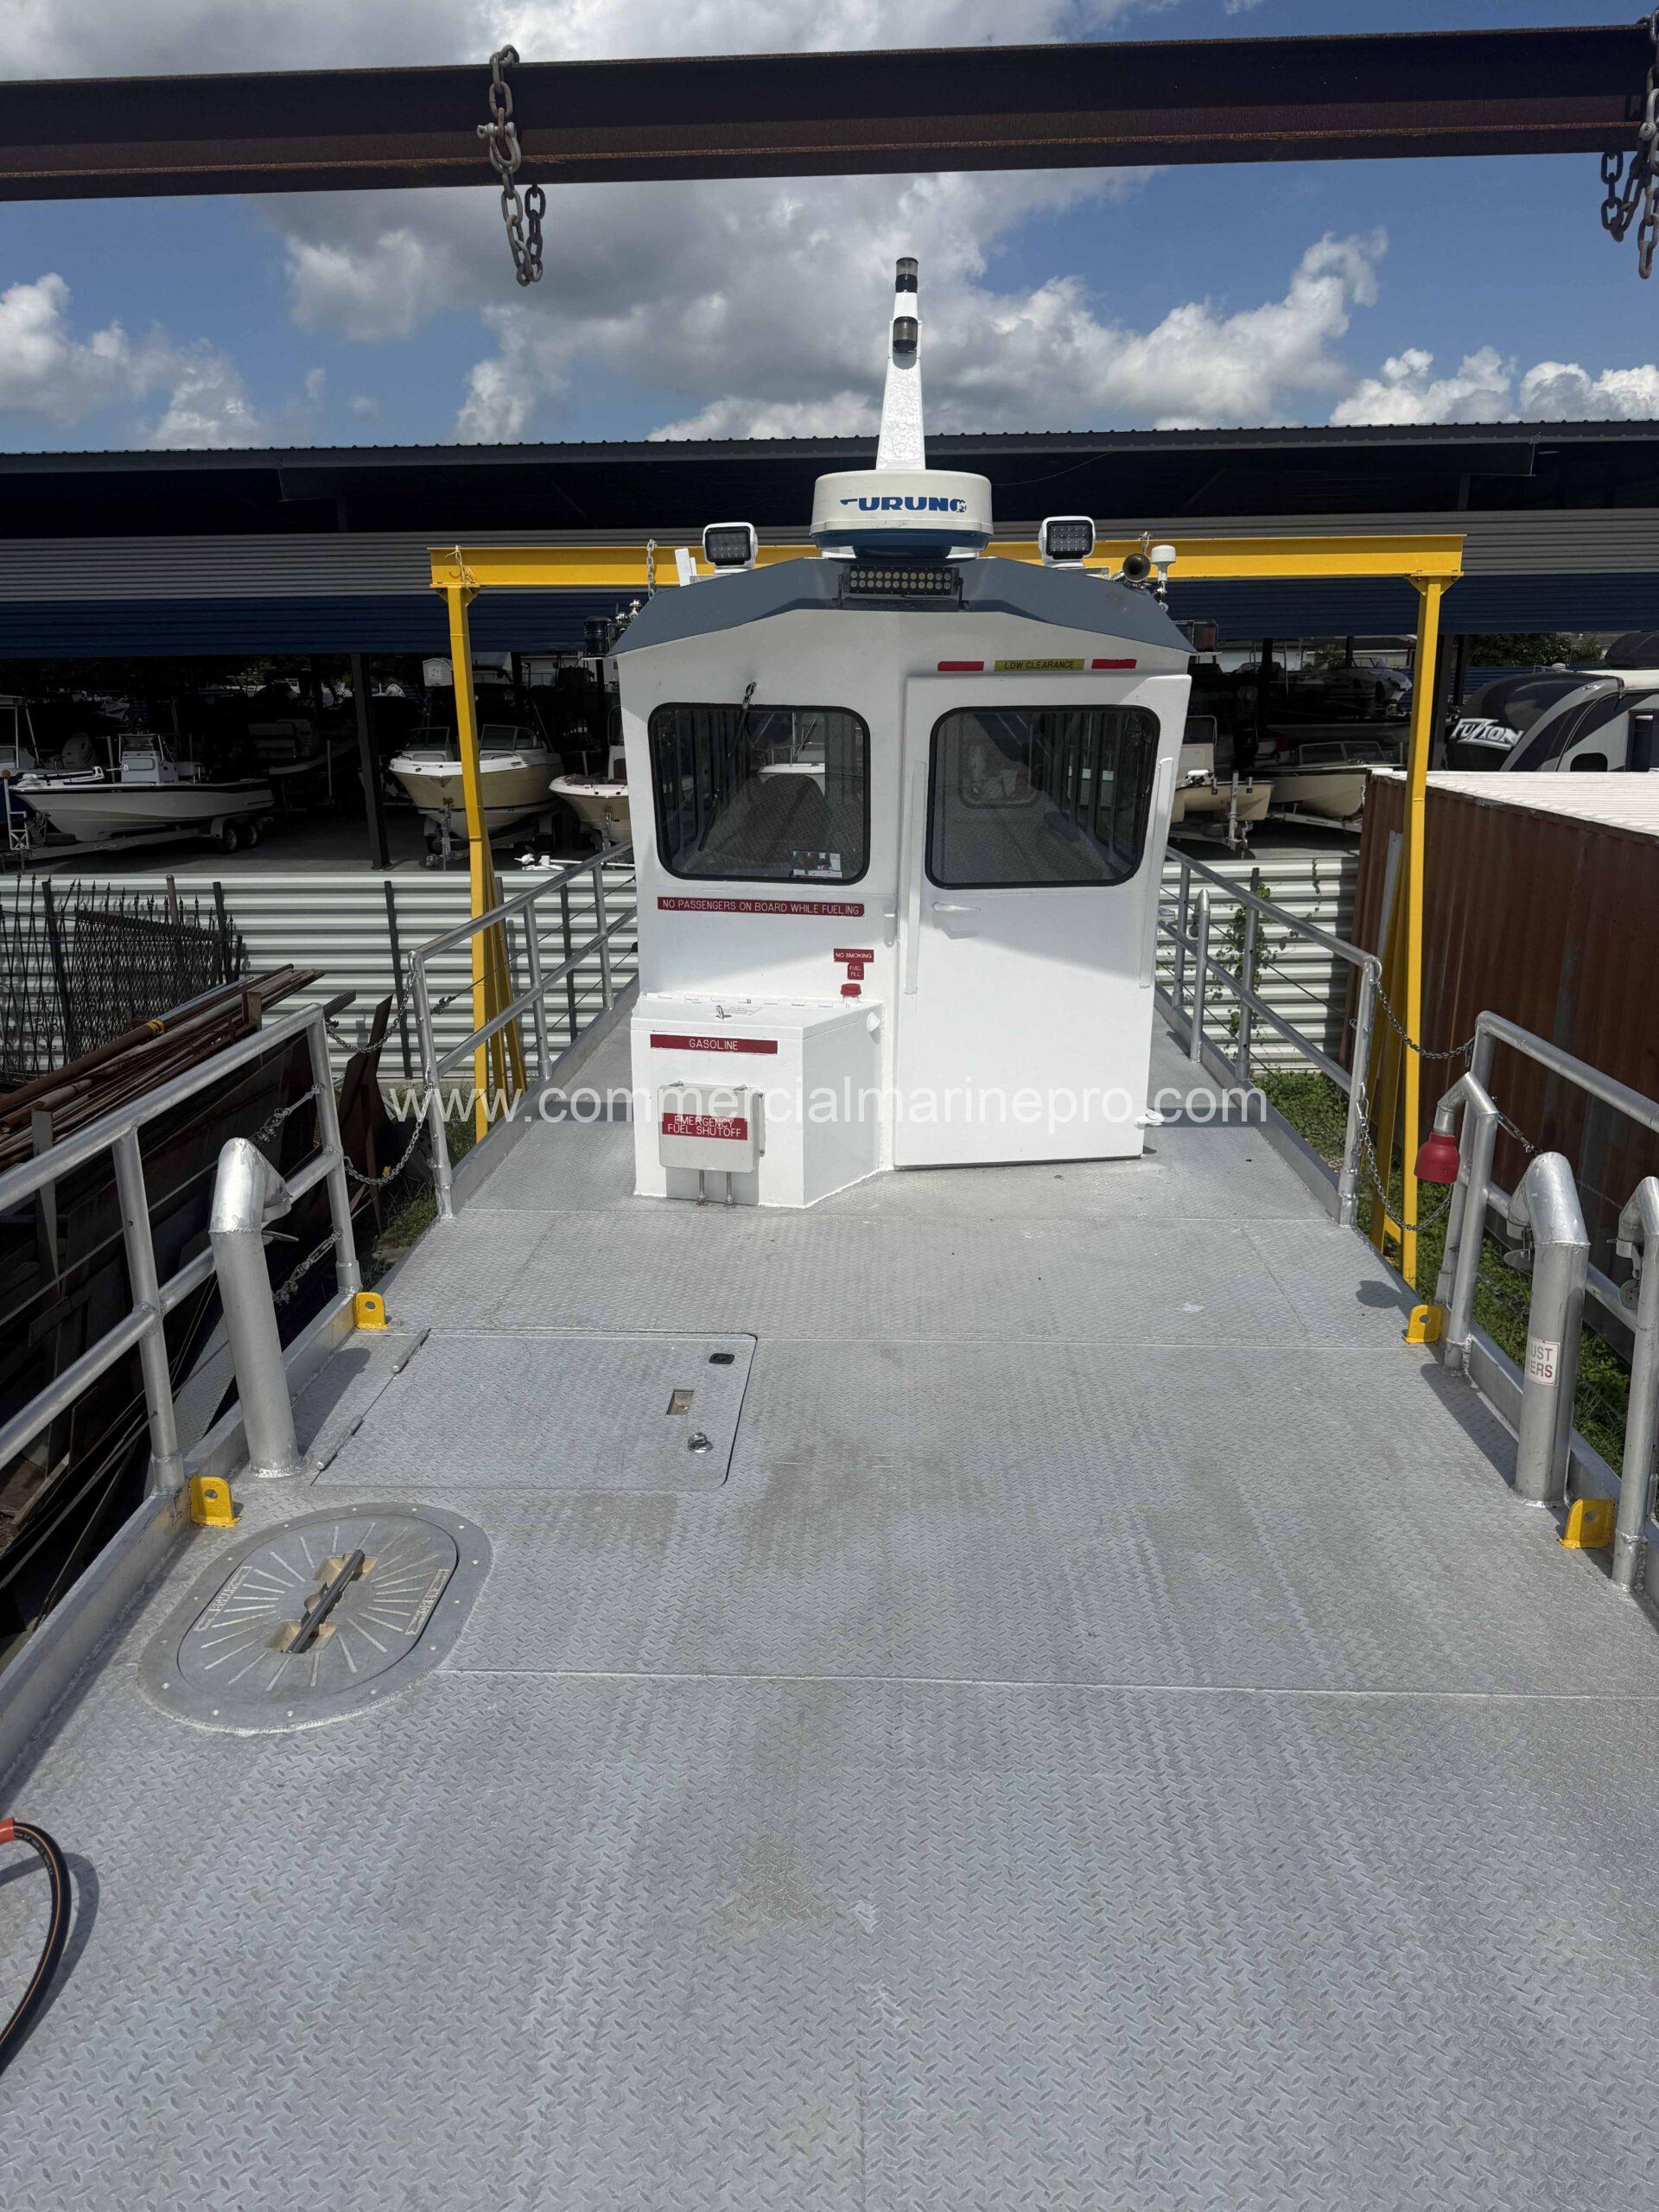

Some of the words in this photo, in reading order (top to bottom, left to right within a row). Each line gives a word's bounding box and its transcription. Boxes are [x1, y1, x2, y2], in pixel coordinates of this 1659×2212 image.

[663, 899, 675, 908] NO
[678, 900, 736, 911] PASSENGERS
[740, 902, 752, 911] ON
[755, 902, 787, 912] BOARD
[791, 904, 819, 913] WHILE
[823, 905, 859, 915] FUELING
[689, 1039, 739, 1051] GASOLINE
[674, 1116, 734, 1128] EMERGENCY
[667, 1124, 692, 1134] FUEL
[696, 1126, 741, 1137] SHUTOFF
